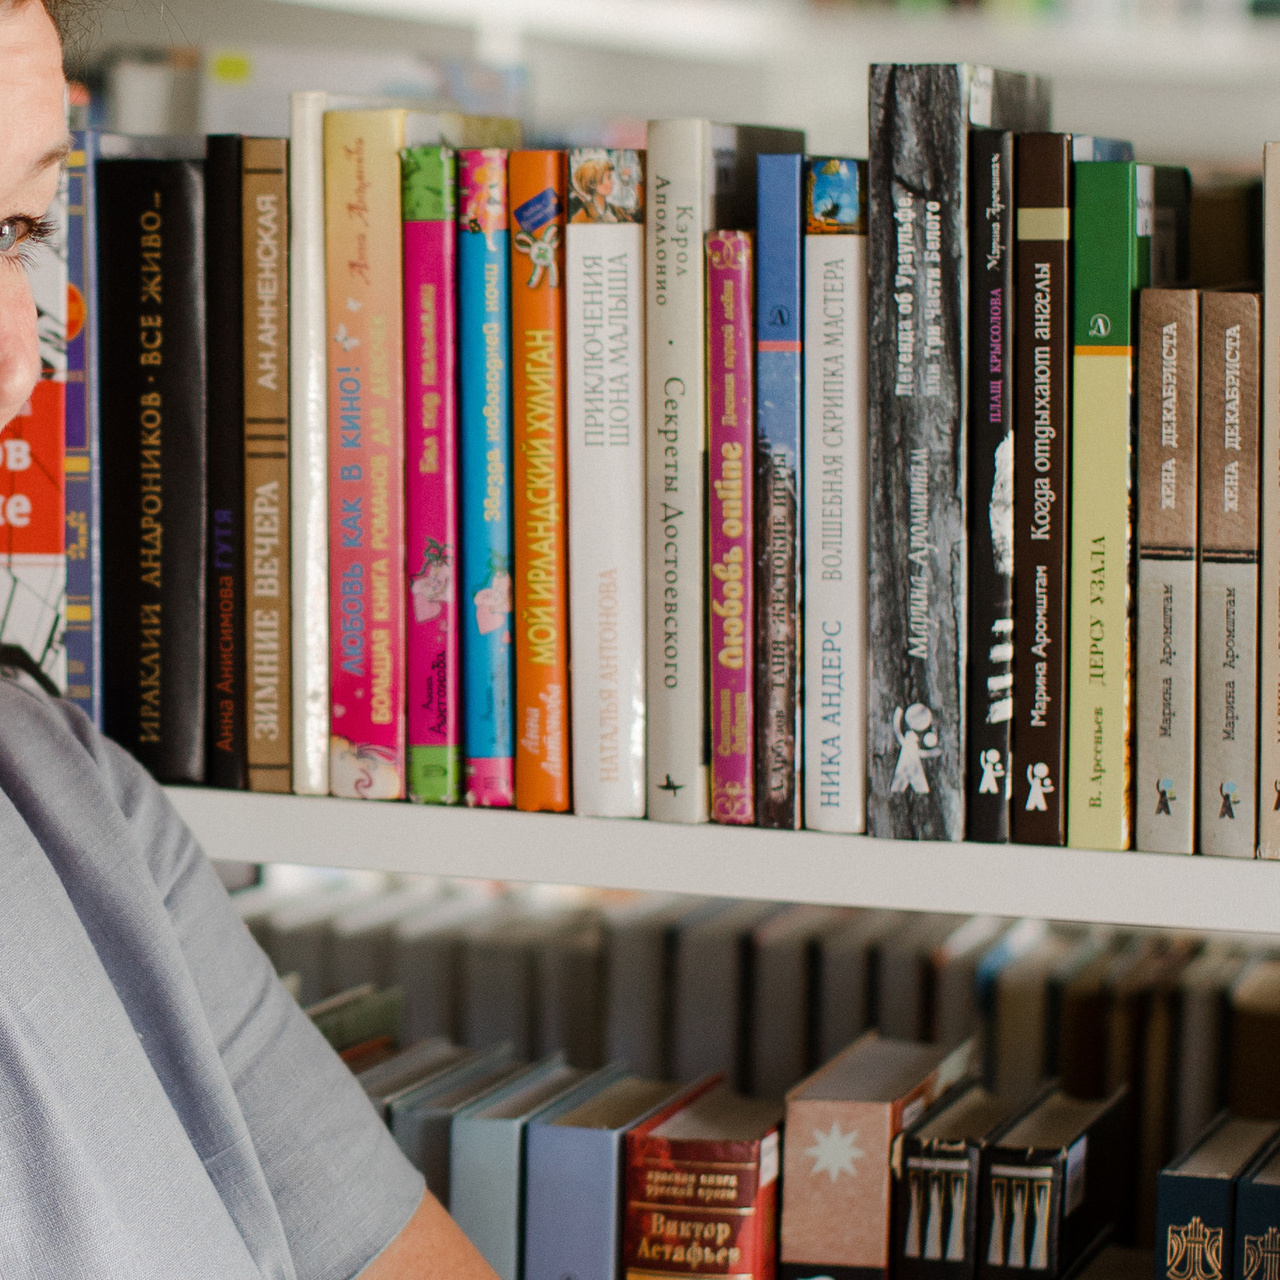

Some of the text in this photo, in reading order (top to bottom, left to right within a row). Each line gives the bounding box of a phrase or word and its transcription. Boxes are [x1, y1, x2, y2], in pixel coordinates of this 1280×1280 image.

[256, 193, 279, 346] АННЕНСКАЯ
[656, 175, 672, 308] Аполлонио
[670, 206, 695, 278] Кэрол
[923, 200, 945, 398] или Три Части Белого
[482, 262, 506, 523] Звезда новогодней ночи
[582, 256, 606, 448] ПРИКЛЮЧЕНИЯ
[607, 252, 631, 448] ШОНА МАЛЫША
[893, 291, 916, 397] Легенда об
[989, 286, 1003, 423] ПЛАЩ КРЫСОЛОВА
[1160, 321, 1179, 510] ЖЕНА ДЕКАБРИСТА
[1223, 323, 1242, 513] ЖЕНА ДЕКАБРИСТА
[138, 315, 164, 743] ИРАКЛИЙ АНДРОНИКОВ ВСЕ
[337, 365, 366, 677] ЛЮБОВЬ КАК В КИНО!
[521, 327, 561, 667] МОЙ ИРЛАНДСКИЙ ХУЛИГАН
[657, 377, 686, 690] Секреты Достоевского
[820, 256, 845, 808] НИКА АНДЕРС ВОЛШЕБНАЯ СКРИПКА МАСТЕРА
[907, 446, 940, 660] Марина Аромштам
[1030, 262, 1056, 727] Марина Аромштам Когда отдыхают ангелы
[214, 509, 235, 753] Анна Анисимова ГУТЯ
[253, 480, 280, 741] ЗИМНИЕ ВЕЧЕРА
[428, 650, 448, 736] Антонова
[598, 567, 620, 783] НАТАЛЬЯ АНТОНОВА
[712, 545, 745, 670] Любовь
[1087, 535, 1107, 809] В. Арсеньев ДЕРСУ УЗАЛА
[1159, 583, 1177, 738] Марина Аромштам
[1222, 586, 1240, 741] Марина Аромштам
[638, 1235, 741, 1270] Астафьев
[650, 1211, 732, 1246] Виктор
